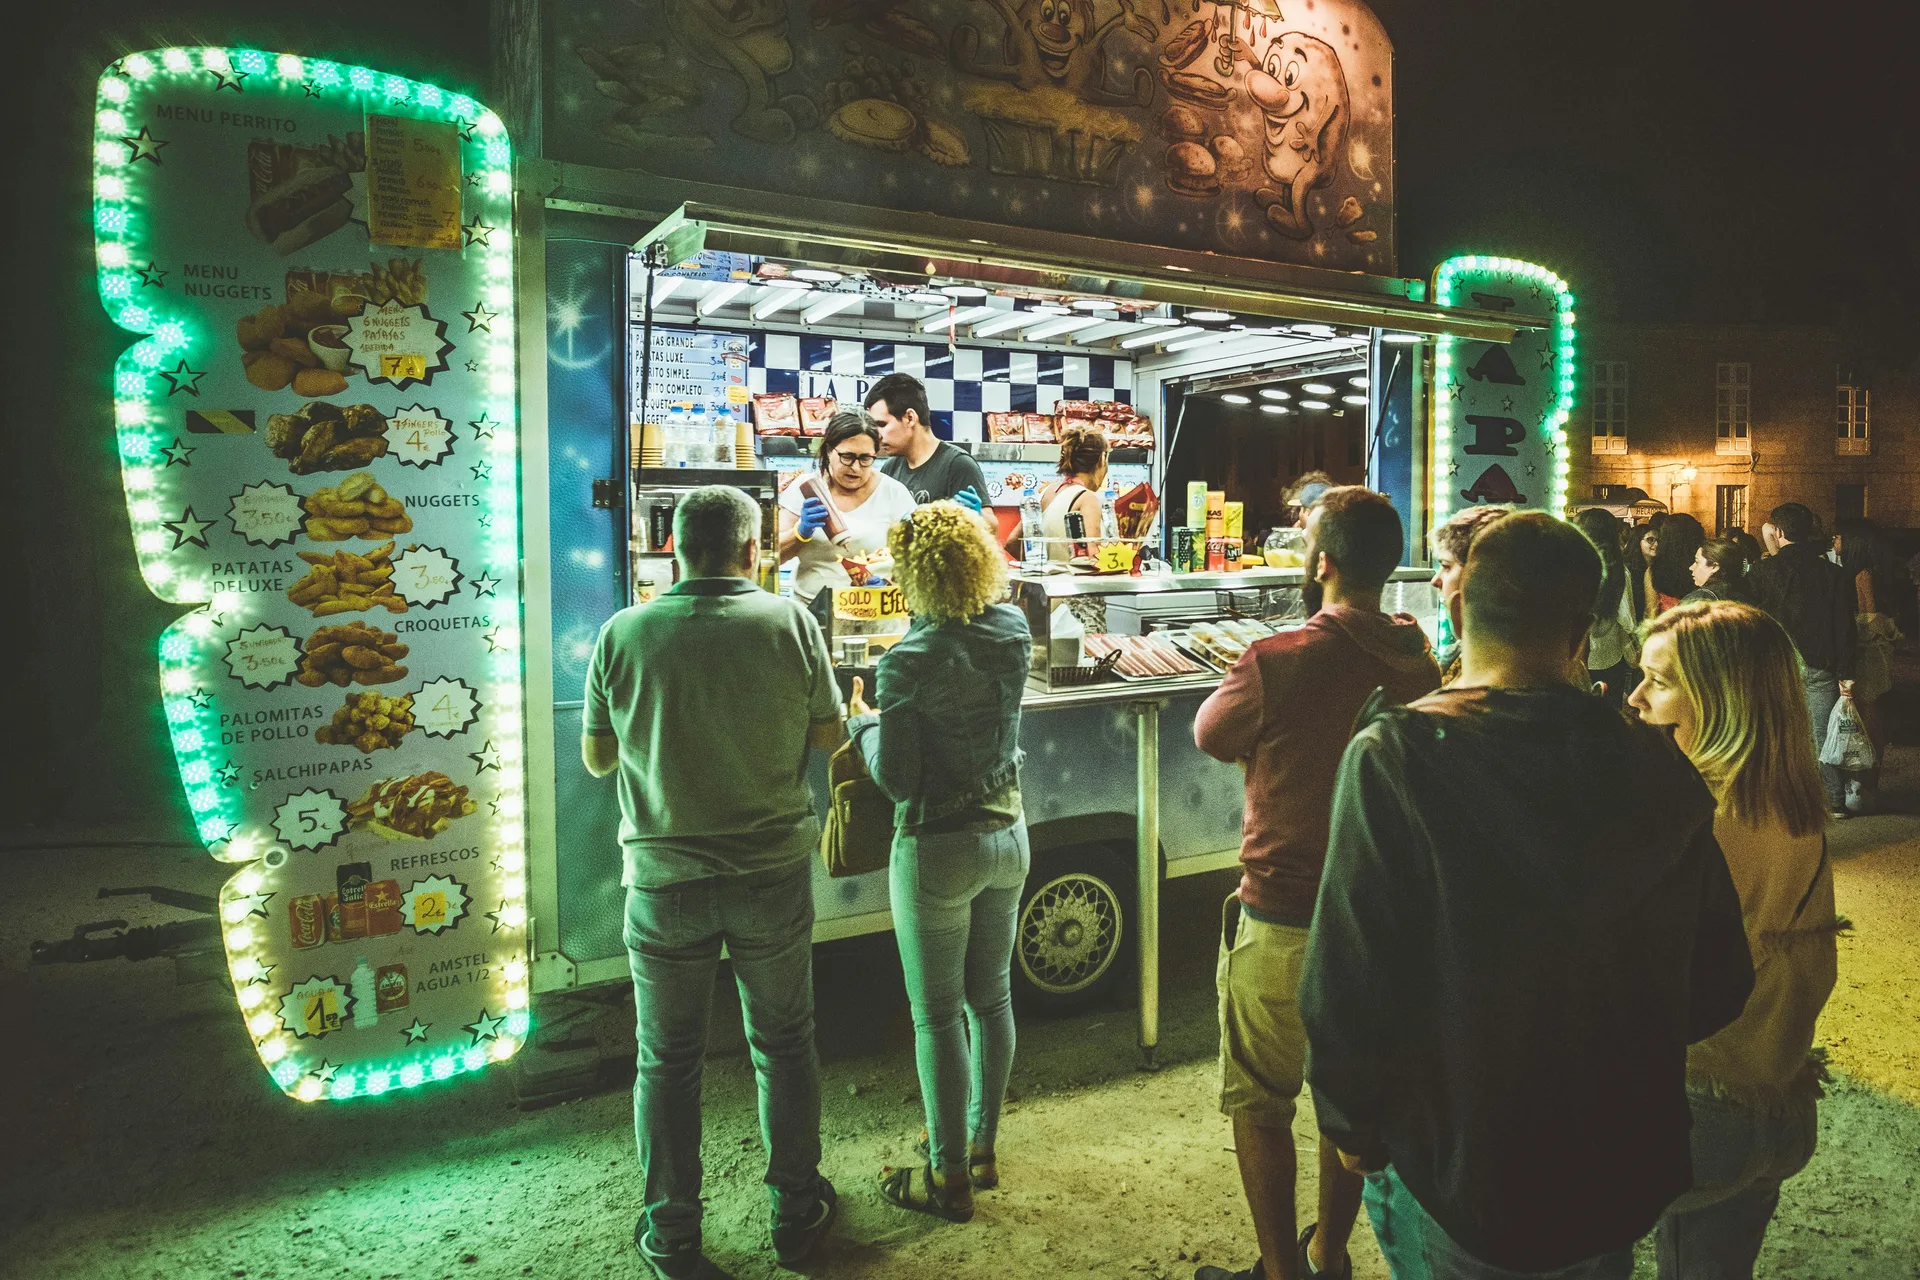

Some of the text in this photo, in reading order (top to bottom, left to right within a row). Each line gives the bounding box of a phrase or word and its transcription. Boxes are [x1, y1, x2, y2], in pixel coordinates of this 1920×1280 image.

[157, 103, 297, 133] MENU PERRITO
[183, 264, 238, 280] MENU
[184, 283, 272, 300] NUGGETS
[635, 333, 664, 346] PATAS
[667, 337, 694, 348] GRANDE
[635, 350, 663, 362] PATAS
[666, 352, 684, 364] LUXE
[635, 366, 664, 378] PERITO
[666, 367, 690, 379] SIMPLE
[635, 382, 664, 394] PRITO
[666, 384, 703, 396] COMPLETO
[636, 398, 676, 410] COQUETA
[636, 414, 667, 425] NGGET
[405, 494, 480, 508] NUGGETS
[212, 560, 293, 576] PATATAS
[213, 578, 284, 593] DELUXE
[839, 591, 871, 606] SOLO
[394, 615, 490, 633] CROQUETAS
[220, 705, 323, 727] PALOMITAS
[221, 725, 309, 745] DE POLLO
[253, 757, 373, 782] SALCHIPAPAS
[390, 846, 479, 871] REFRESCOS
[429, 953, 489, 974] AMSTEL
[416, 968, 490, 993] AGUA 1/2
